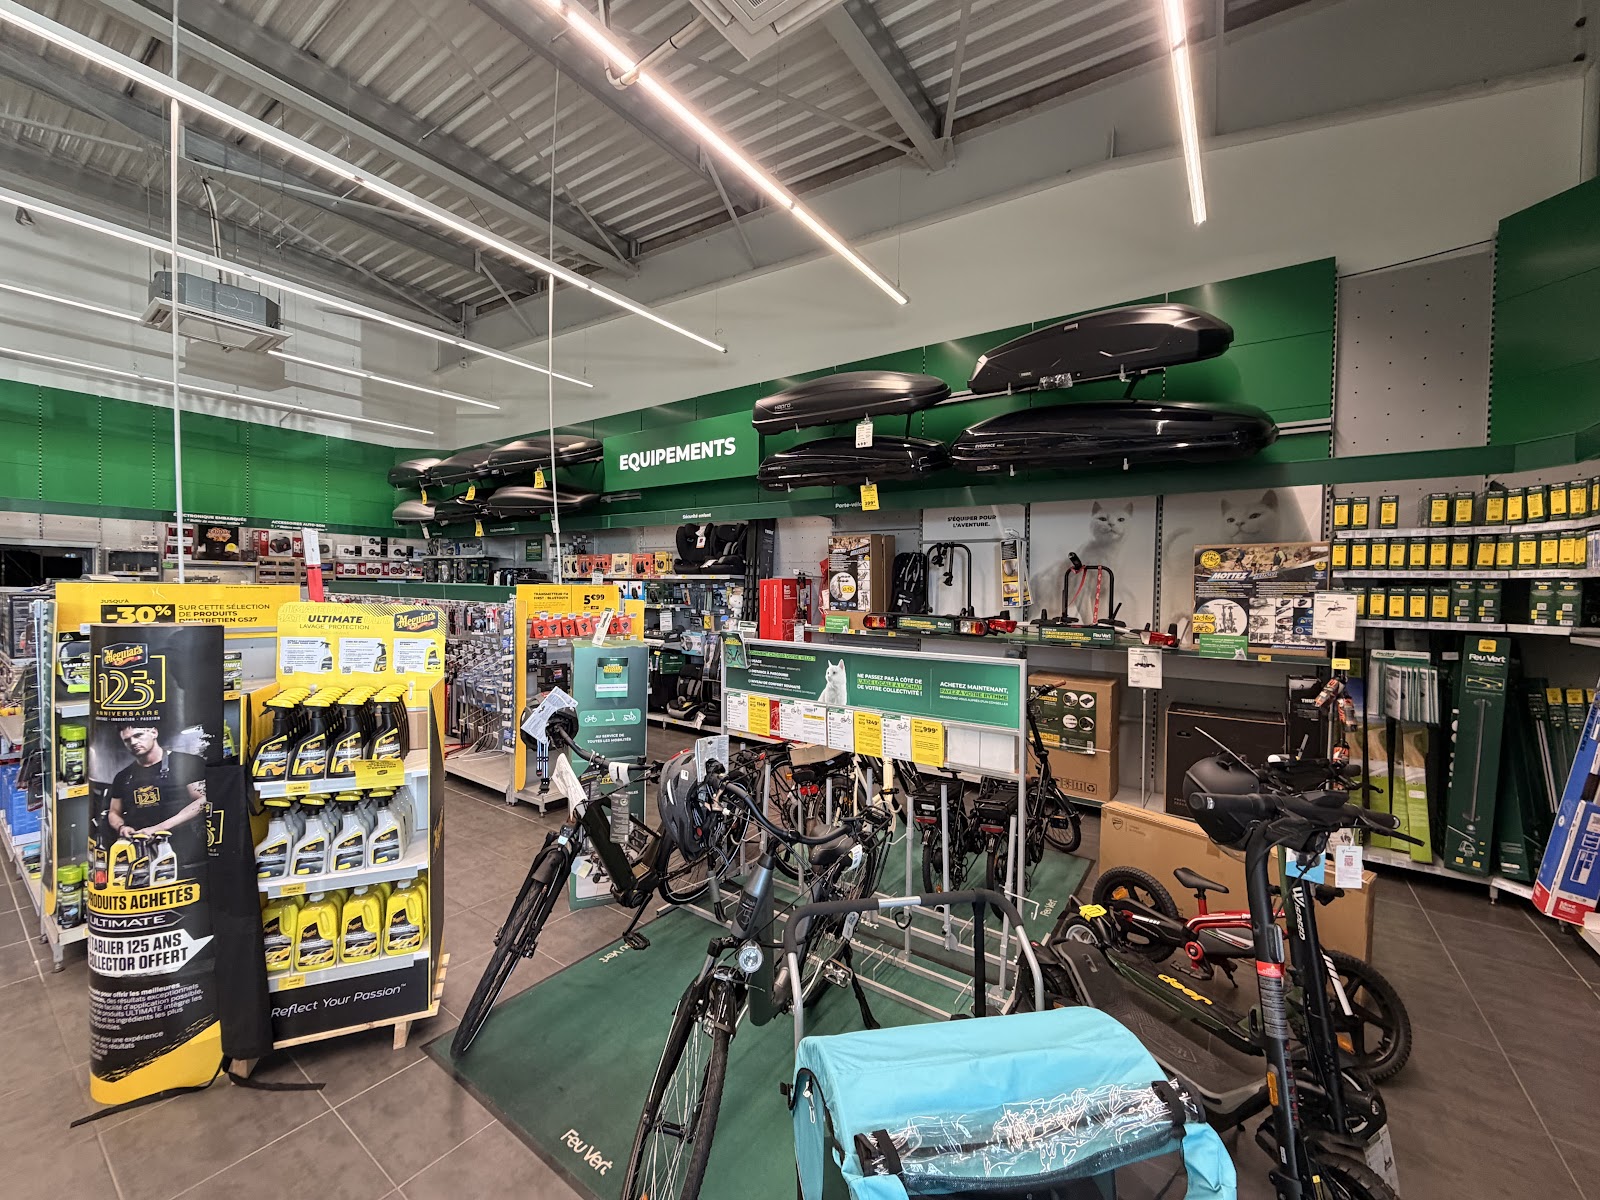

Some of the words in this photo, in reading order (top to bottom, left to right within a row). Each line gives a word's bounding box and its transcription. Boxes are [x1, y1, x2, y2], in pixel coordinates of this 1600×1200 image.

[619, 437, 736, 472] EQUIPEMENTS
[1212, 572, 1248, 580] MOTTEZ
[106, 605, 172, 624] -30%
[308, 615, 363, 624] ULTIMATE
[395, 611, 437, 630] Meguiar's
[103, 644, 144, 667] Meguiar's
[1468, 653, 1486, 661] Feu
[1486, 654, 1507, 663] Vert
[883, 687, 919, 695] COLLECTIVITÉ
[940, 681, 966, 689] ACHETEZ
[966, 684, 1009, 694] MAINTENANT,
[983, 691, 1008, 700] RYTHME
[130, 886, 194, 910] ACHETÉS
[89, 915, 166, 928] ULTIMATE
[90, 938, 124, 955] TABLIER
[126, 937, 150, 954] 125
[152, 932, 182, 951] ANS
[138, 946, 189, 969] OFFERT
[112, 990, 128, 998] offrir
[140, 982, 181, 995] meilleures
[117, 995, 146, 1004] résultats
[146, 983, 199, 1001] exceptionnels
[122, 997, 170, 1011] d'application
[170, 989, 204, 1002] possible,
[125, 1006, 164, 1017] ULTIMATE
[163, 999, 190, 1011] intègre
[191, 994, 203, 1002] les
[270, 1001, 319, 1018] Reflect
[322, 995, 351, 1009] Your
[115, 1013, 154, 1025] ingrédients
[154, 1011, 167, 1019] les
[166, 1006, 184, 1017] plus
[124, 1031, 164, 1043] expérience
[560, 1128, 589, 1153] Feu
[582, 1144, 614, 1176] Vert
